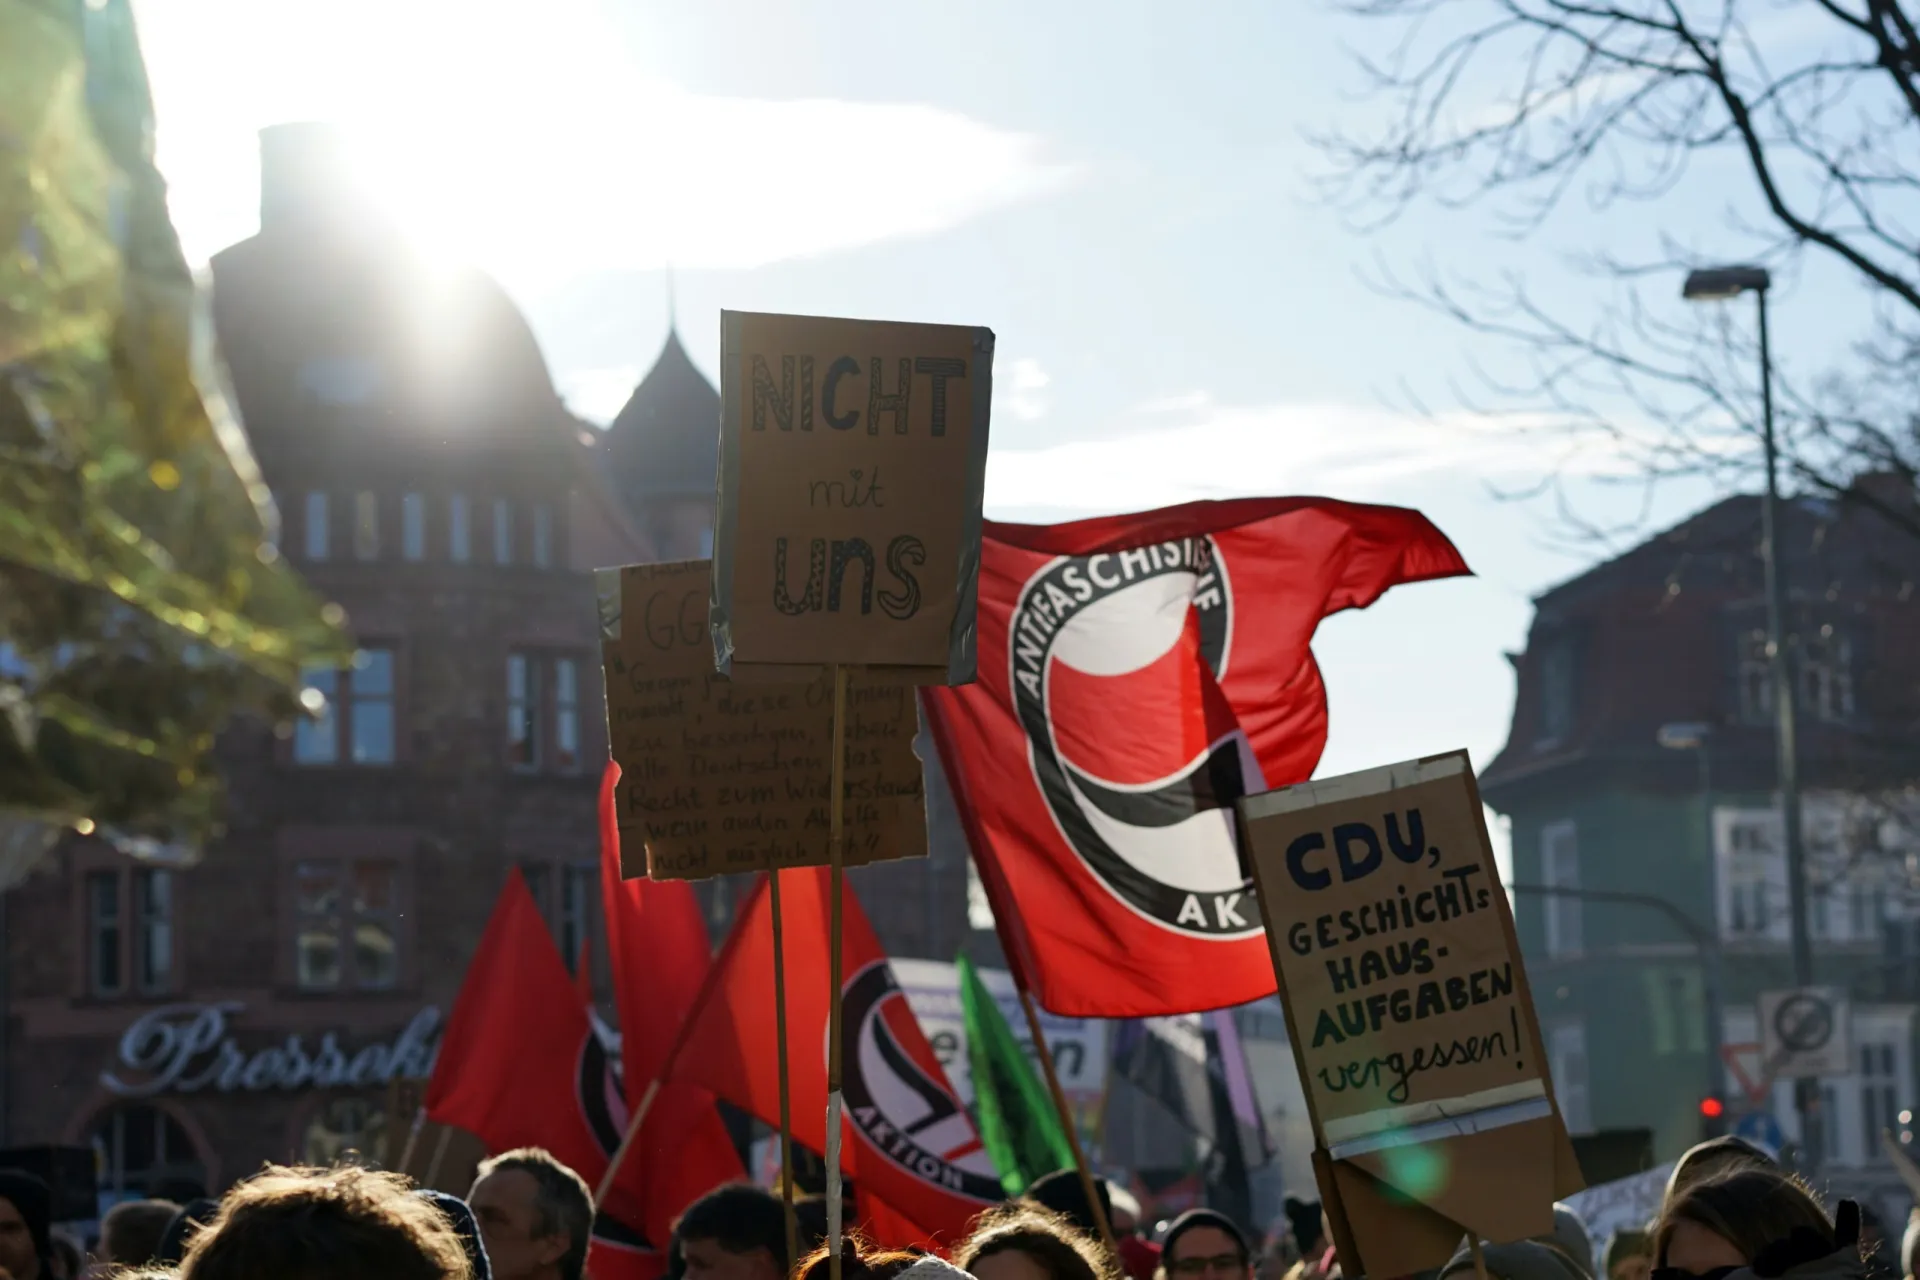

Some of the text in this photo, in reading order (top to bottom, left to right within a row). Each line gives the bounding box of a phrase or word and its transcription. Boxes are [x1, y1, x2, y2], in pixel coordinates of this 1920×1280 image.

[752, 354, 966, 437] NICHT
[809, 466, 885, 508] mit
[1285, 808, 1441, 892] CDU,
[1311, 962, 1513, 1048] AUFGABEN
[1325, 937, 1449, 994] HAUS-
[1317, 1006, 1524, 1101] vergessen!
